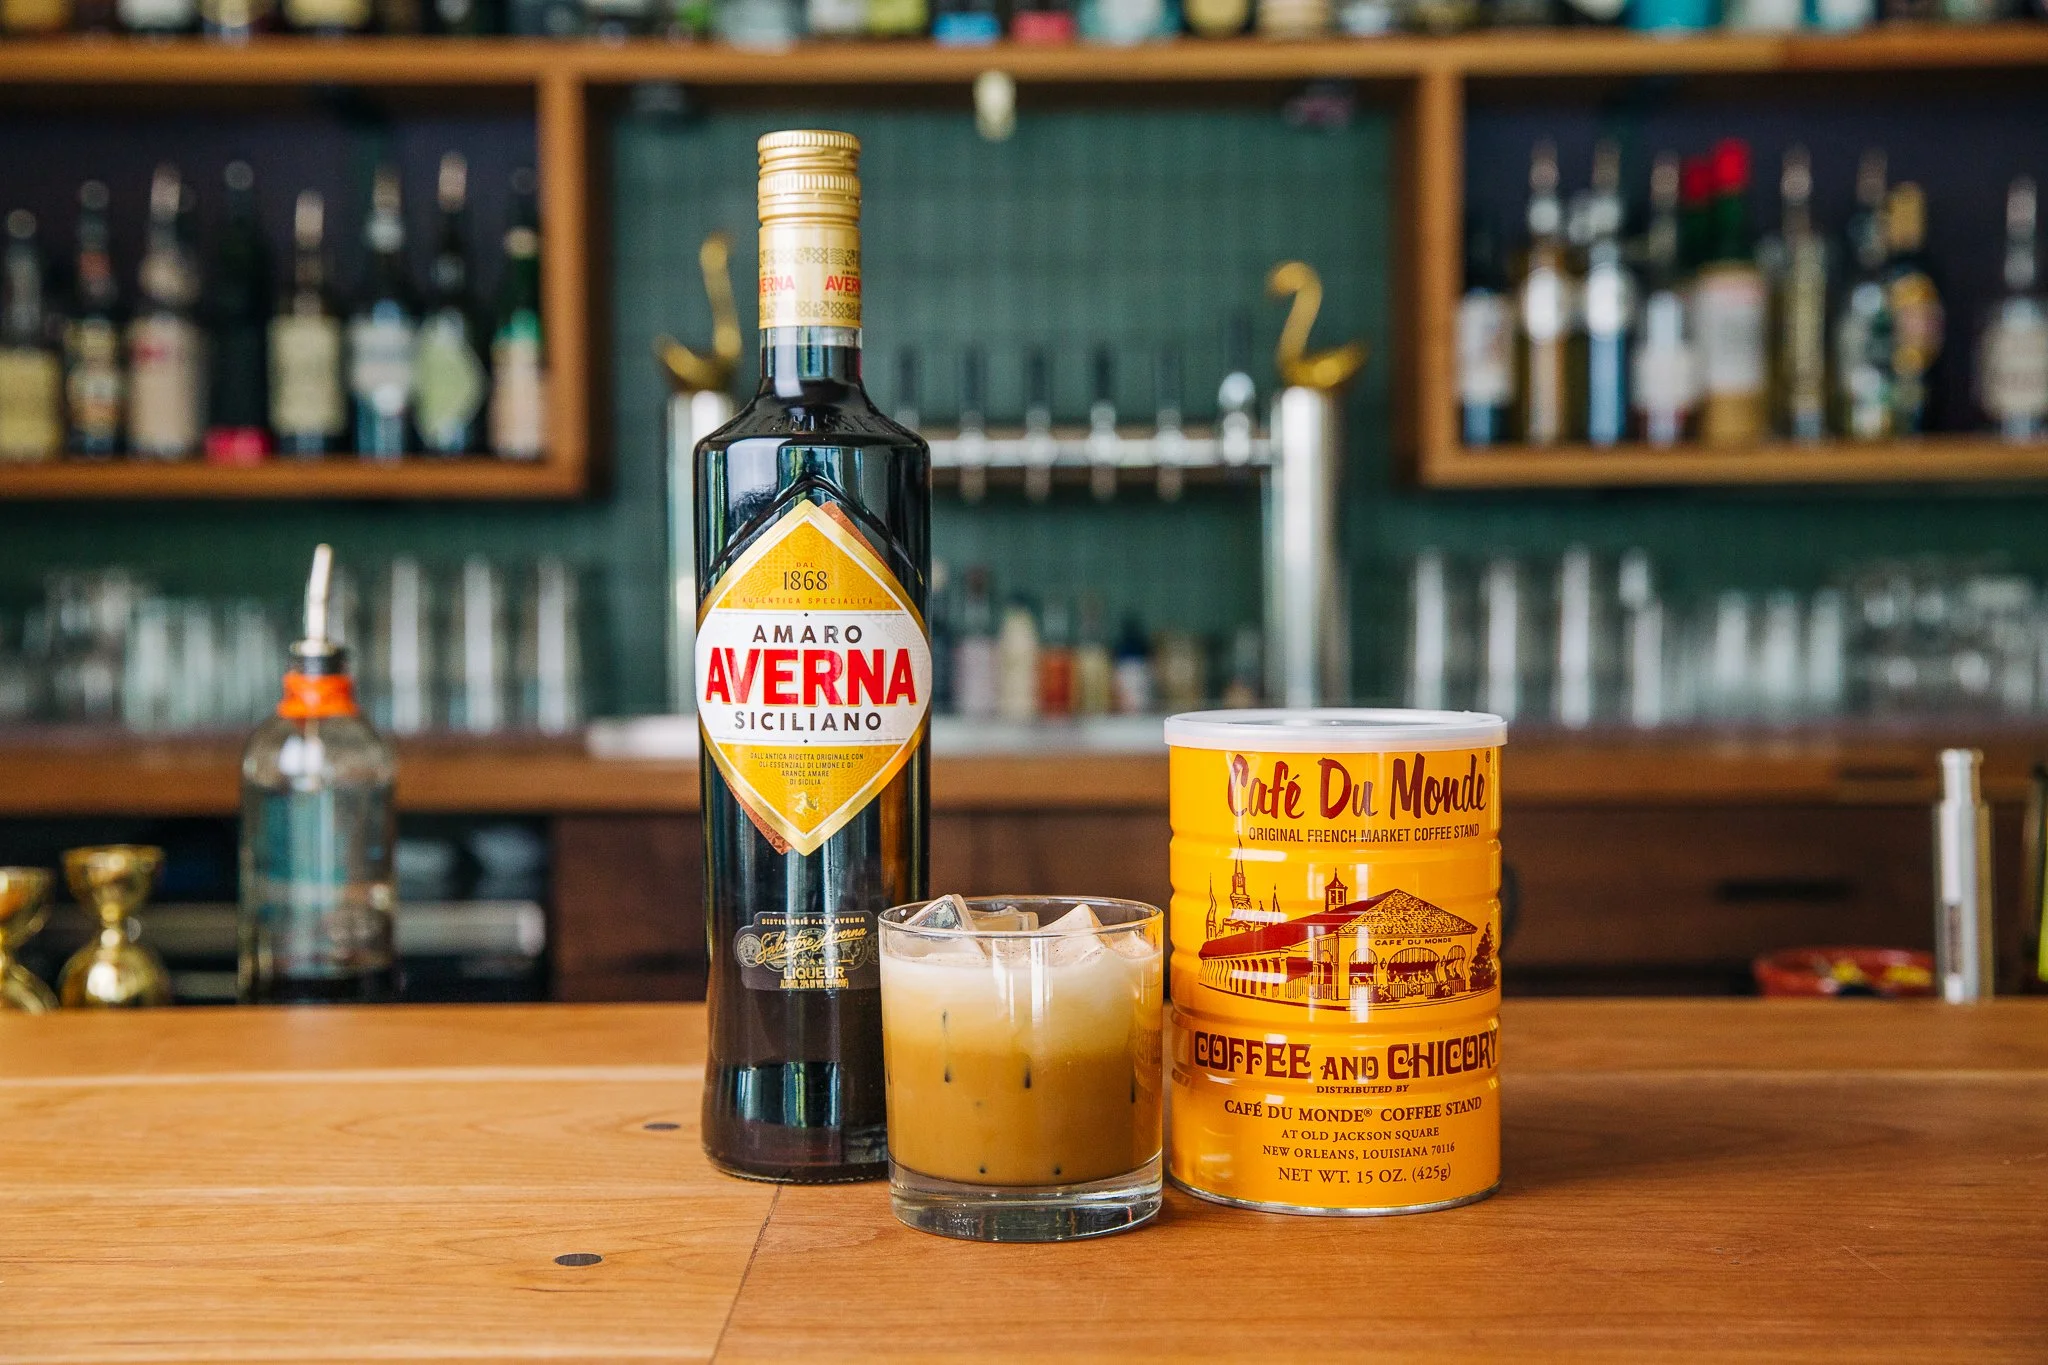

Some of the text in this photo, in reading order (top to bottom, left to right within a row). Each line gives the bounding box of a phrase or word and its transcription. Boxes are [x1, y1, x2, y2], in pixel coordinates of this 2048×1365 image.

[783, 570, 828, 590] 1868
[752, 625, 863, 644] AMARO
[705, 647, 917, 706] AVERNA
[734, 711, 882, 732] SICILIANO
[788, 753, 815, 761] RICETTA
[816, 753, 849, 761] ORIGINALE
[1227, 753, 1305, 819] Café
[1317, 757, 1378, 820] Du
[1248, 823, 1481, 843] ORIGINAL FRENCH MARKET COFFEE STAND
[783, 966, 845, 979] LIQUEUR
[1194, 1028, 1498, 1081] COFFEE AND CHICORY
[1316, 1084, 1410, 1094] DISTRIBUTED BY
[1224, 1099, 1263, 1118] CAFÉ
[1267, 1105, 1293, 1119] DU
[1380, 1104, 1442, 1122] COFFEE
[1446, 1096, 1482, 1117] STAND
[1281, 1126, 1440, 1142] AT OLD JACKSON SQUARE
[1262, 1142, 1455, 1161] NEW ORLEANS, LOUISIANA 70116
[1278, 1163, 1451, 1184] NET WT. 15 OZ. (425g)
